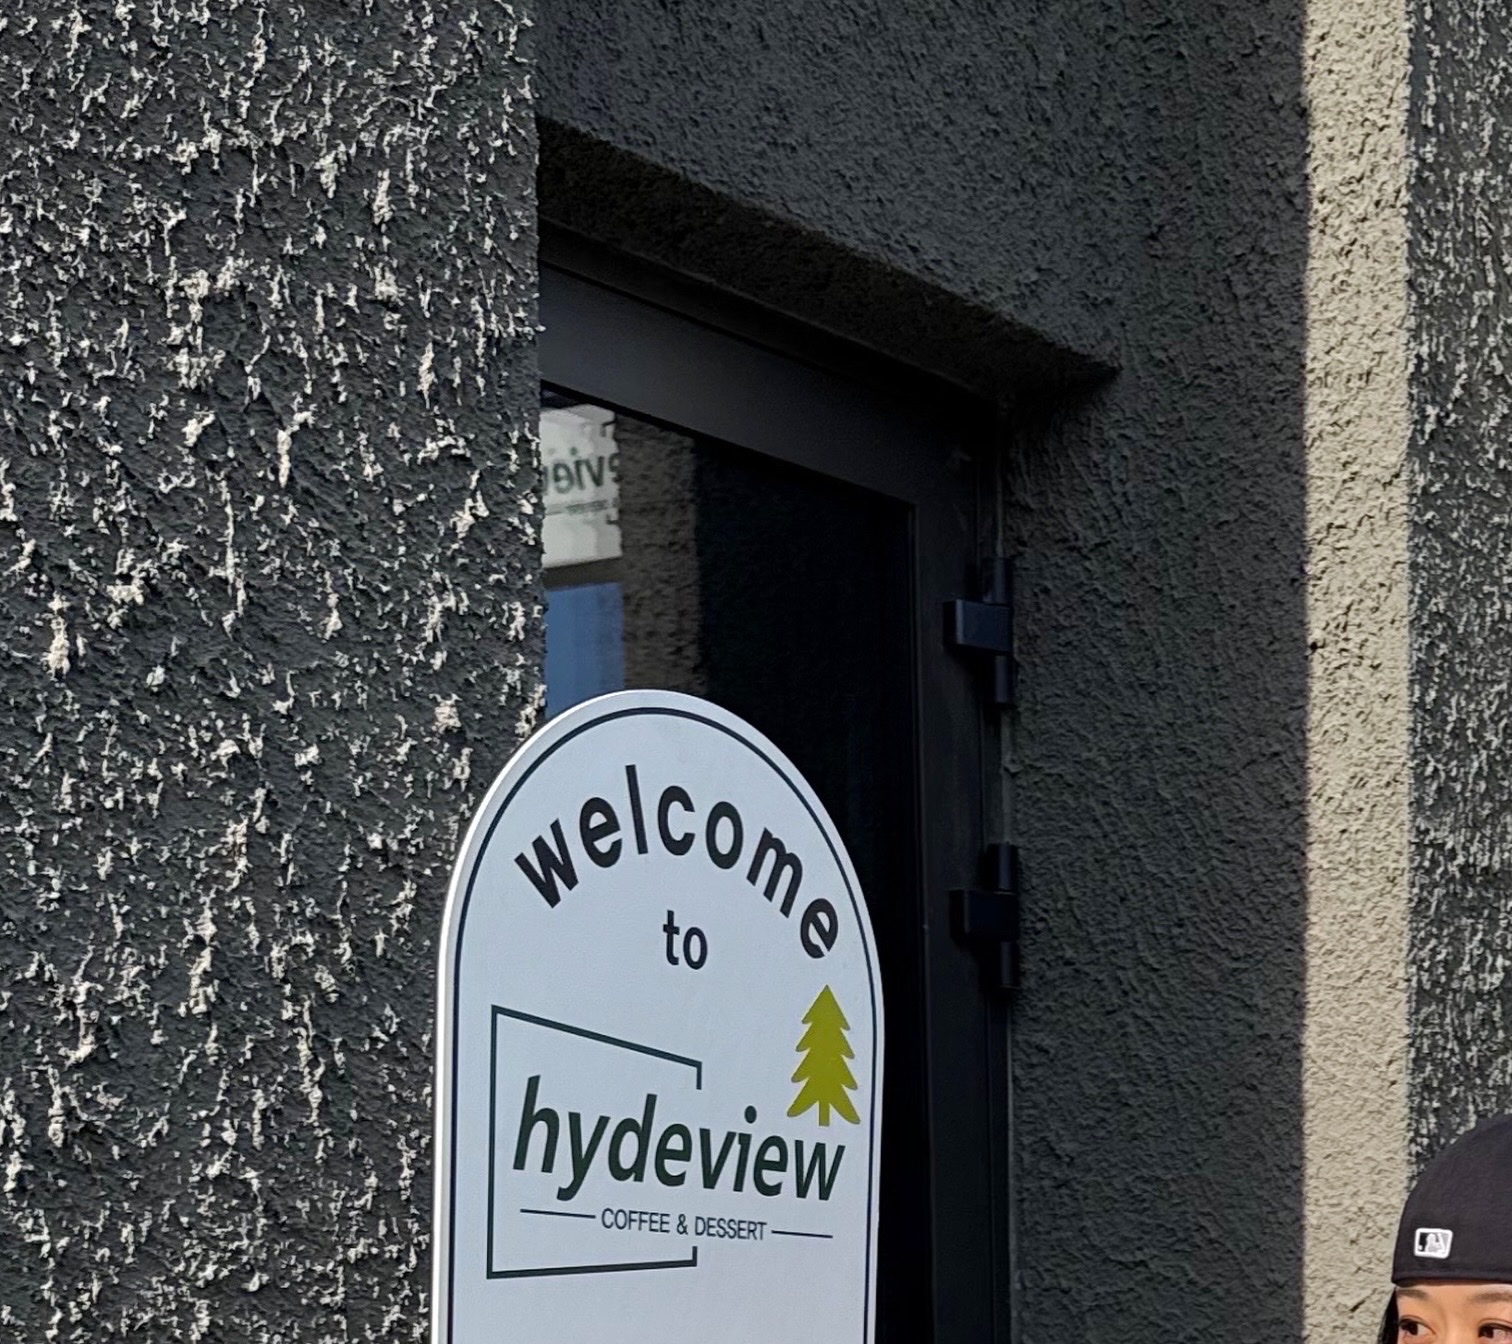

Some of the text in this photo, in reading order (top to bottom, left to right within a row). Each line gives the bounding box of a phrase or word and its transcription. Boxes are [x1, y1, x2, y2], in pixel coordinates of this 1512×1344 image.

[514, 764, 839, 959] welcome
[662, 909, 708, 970] to
[512, 1074, 846, 1202] hydeview
[601, 1208, 768, 1241] COFFEE & DESSERT
